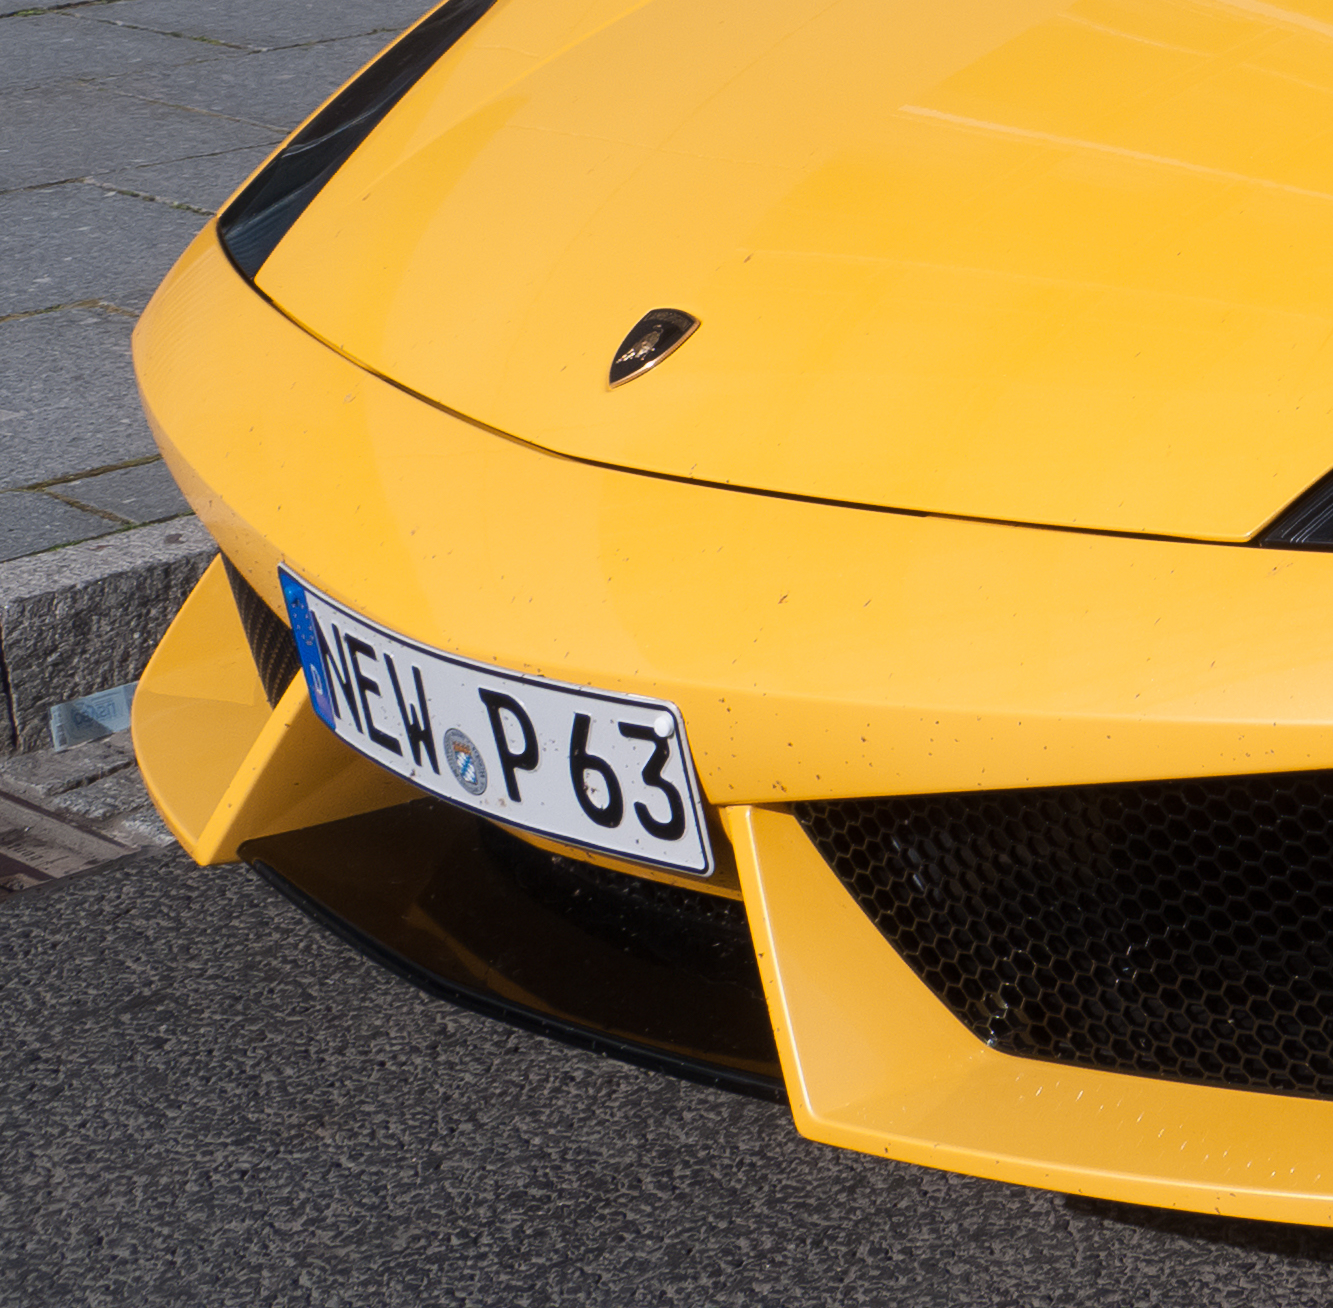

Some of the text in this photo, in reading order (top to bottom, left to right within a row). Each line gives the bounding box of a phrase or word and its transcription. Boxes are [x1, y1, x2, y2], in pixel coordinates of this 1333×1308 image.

[310, 609, 441, 776] NEW
[478, 686, 540, 803] P
[569, 712, 687, 842] 63
